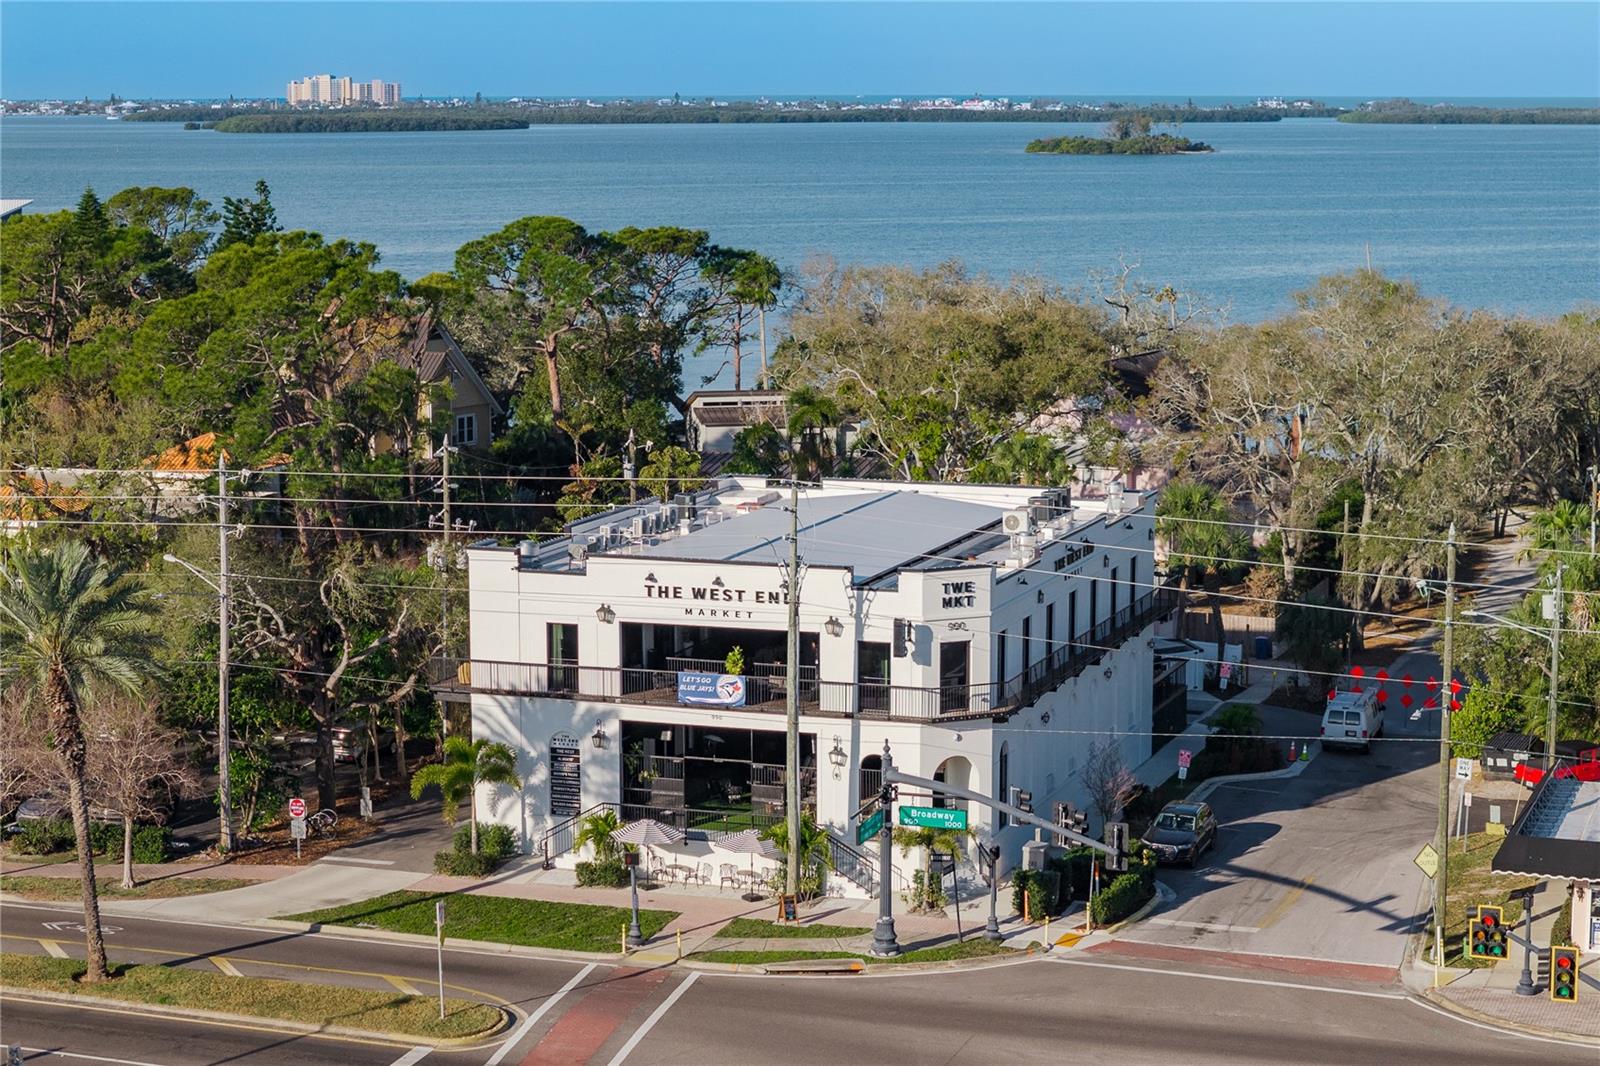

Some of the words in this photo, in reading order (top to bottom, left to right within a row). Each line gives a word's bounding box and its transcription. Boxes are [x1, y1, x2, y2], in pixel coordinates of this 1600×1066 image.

[644, 584, 683, 599] THE
[691, 587, 746, 603] WEST
[942, 581, 975, 595] TWE
[942, 595, 976, 608] MKT
[684, 608, 753, 619] MARKET
[697, 685, 715, 693] JAYS!
[911, 809, 955, 821] Broadway
[945, 821, 962, 829] 1000
